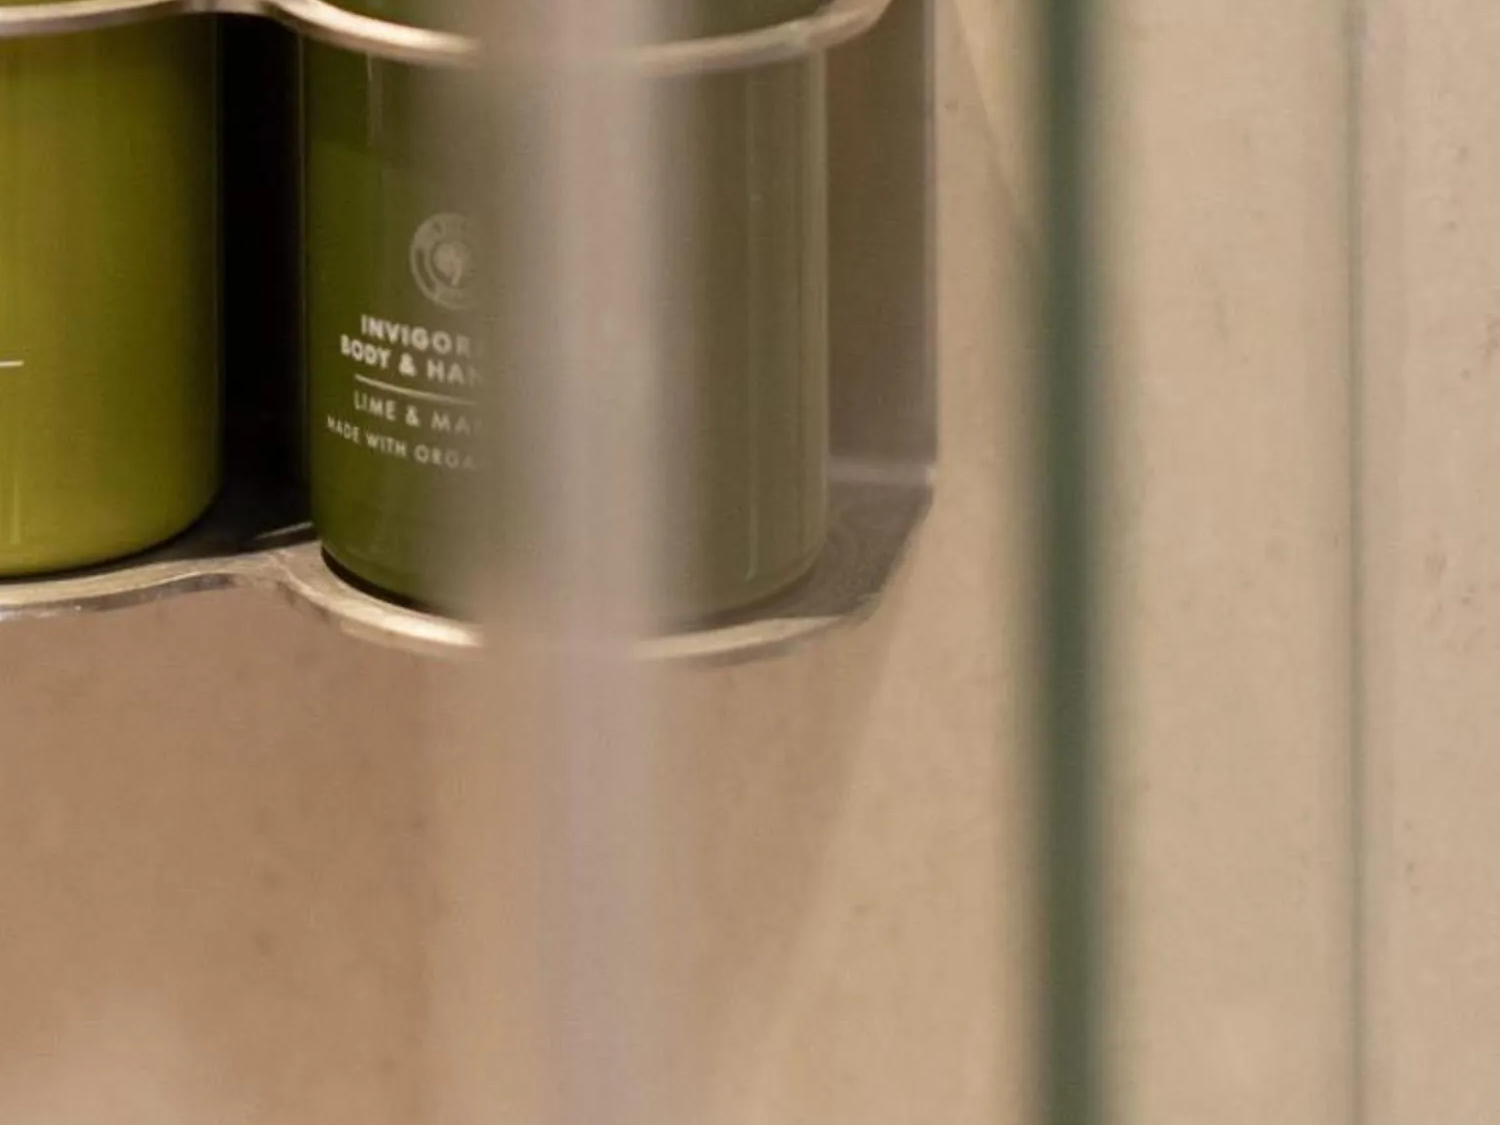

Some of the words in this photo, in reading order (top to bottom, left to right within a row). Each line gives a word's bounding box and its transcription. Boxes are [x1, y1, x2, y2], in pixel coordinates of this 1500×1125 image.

[340, 334, 391, 369] BODY
[399, 352, 417, 377] &
[354, 390, 397, 421] LIME
[405, 404, 420, 427] &
[366, 431, 407, 457] WITH
